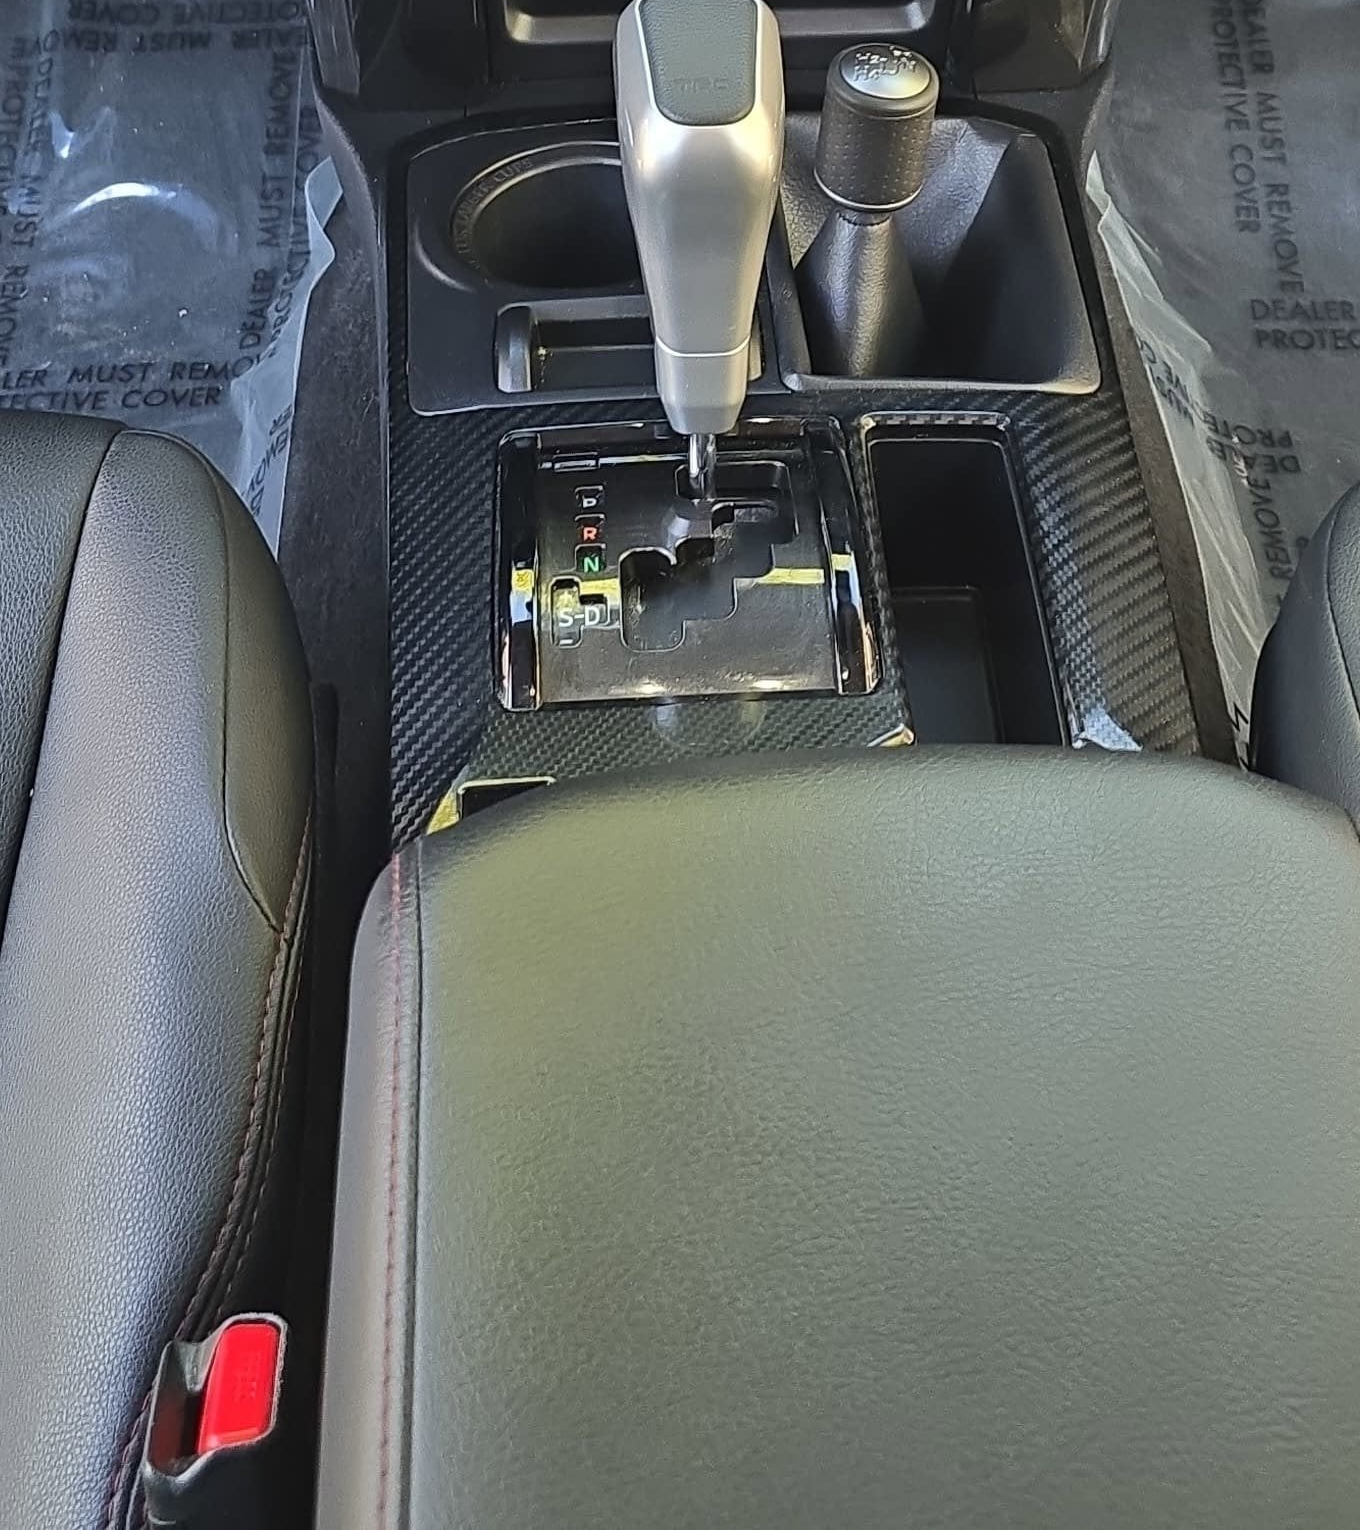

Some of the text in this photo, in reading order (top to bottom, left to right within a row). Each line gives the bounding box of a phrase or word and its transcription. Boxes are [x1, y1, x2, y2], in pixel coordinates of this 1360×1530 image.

[231, 26, 307, 51] EALER
[1256, 91, 1288, 167] MUST
[1229, 141, 1263, 236] COVER
[1263, 181, 1306, 295] REMOVE
[1250, 298, 1358, 323] DEALER
[66, 361, 157, 385] MUST
[121, 385, 225, 410] COVER
[581, 497, 597, 509] P
[583, 526, 598, 540] R
[583, 557, 600, 573] N
